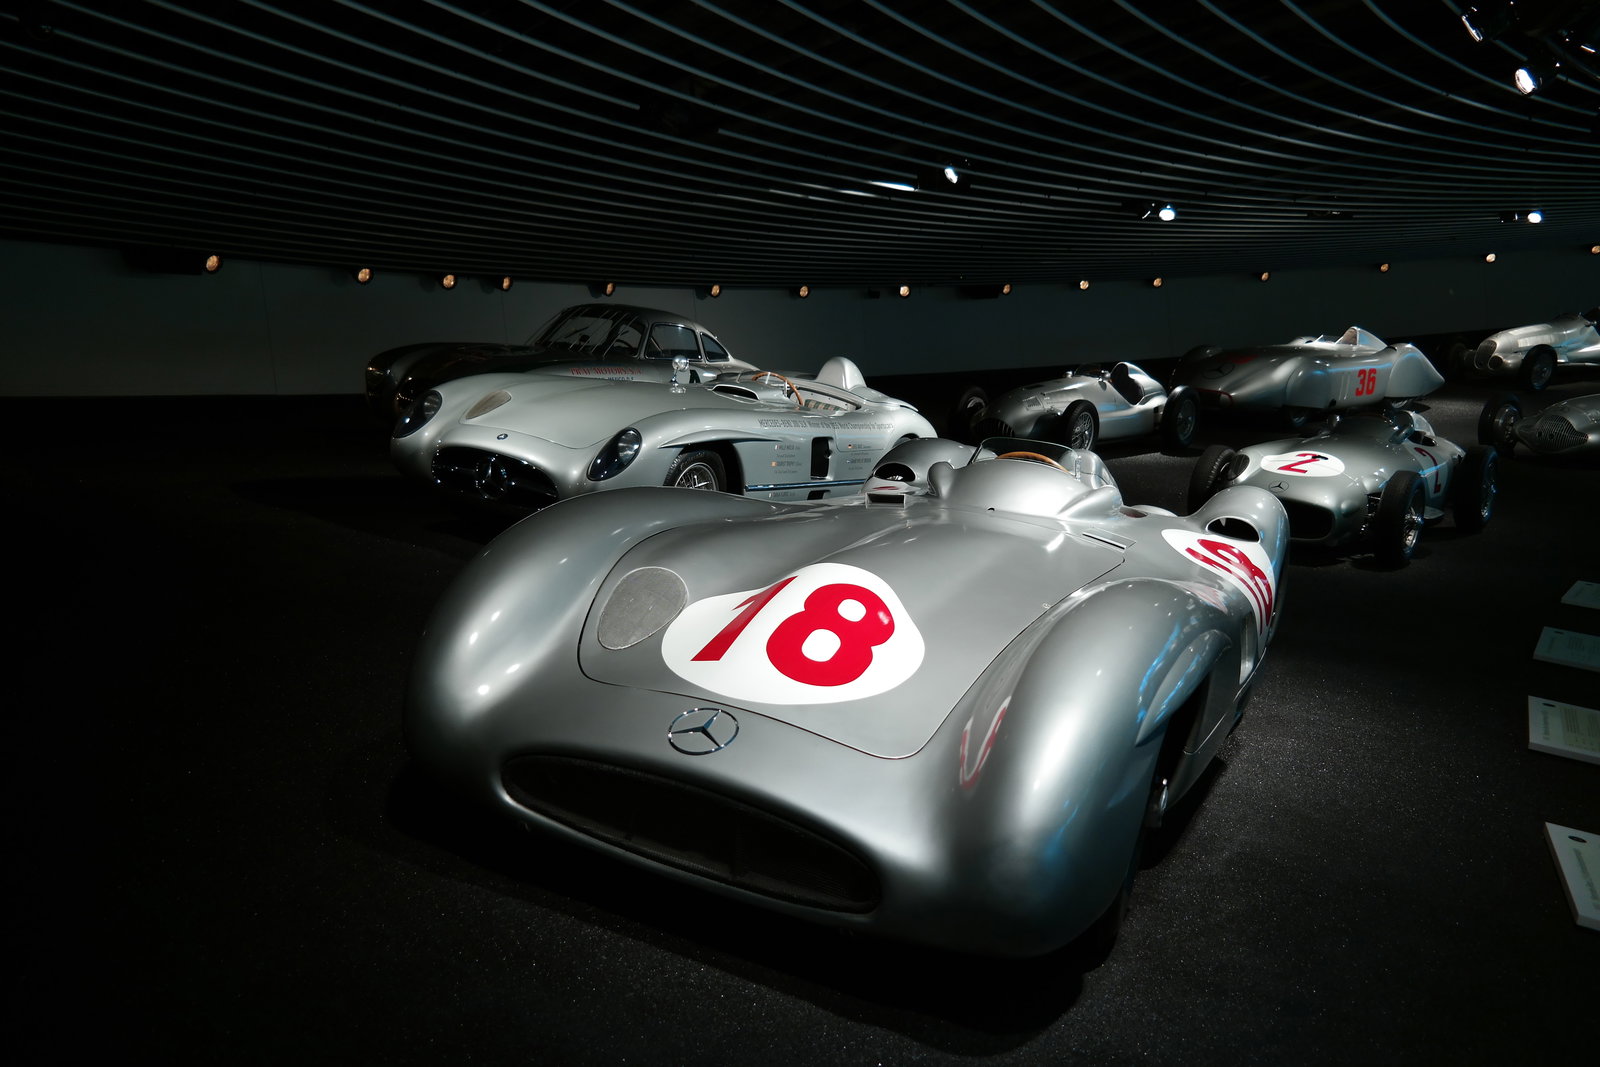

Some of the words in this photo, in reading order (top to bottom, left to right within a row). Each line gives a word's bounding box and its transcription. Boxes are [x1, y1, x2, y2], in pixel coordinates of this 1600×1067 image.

[1356, 368, 1377, 397] 36
[1278, 453, 1327, 474] 2
[1183, 538, 1274, 637] 18
[690, 575, 896, 688] 18
